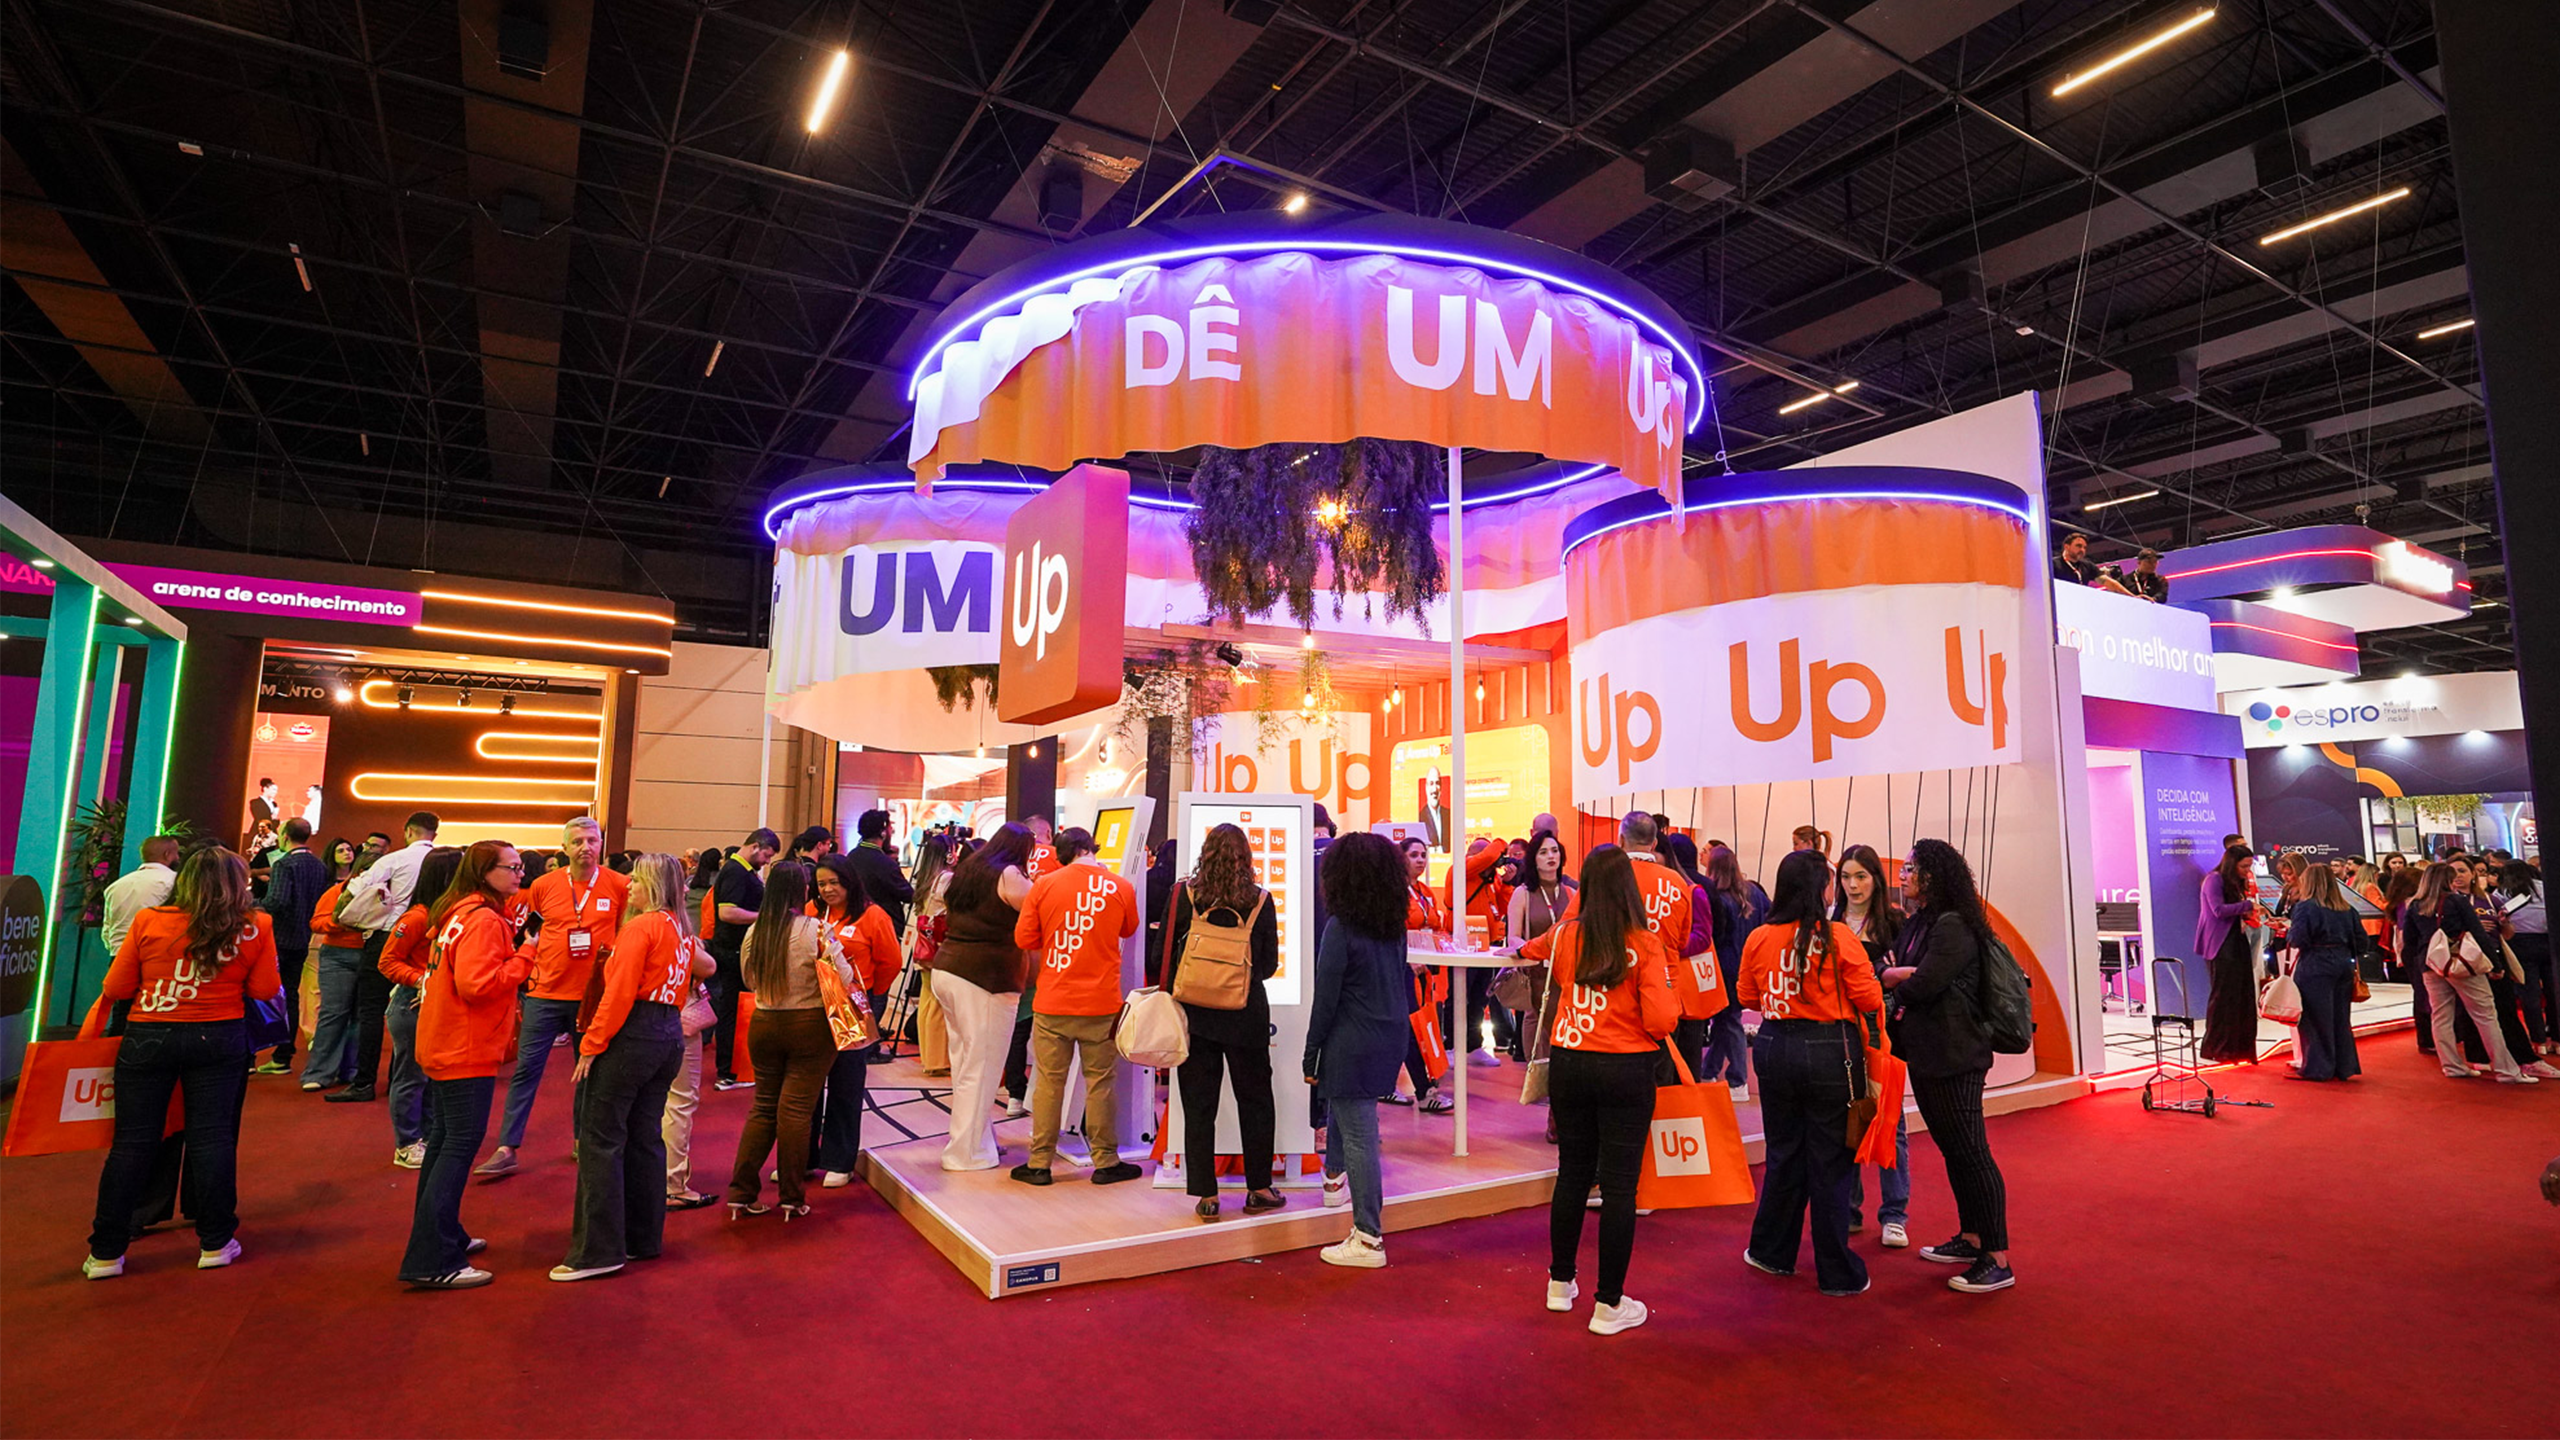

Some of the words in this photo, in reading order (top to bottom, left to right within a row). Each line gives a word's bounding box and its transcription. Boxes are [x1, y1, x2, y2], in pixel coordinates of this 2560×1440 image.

[1125, 284, 1241, 389] DÊ
[1386, 285, 1552, 409] UM
[153, 582, 220, 599] arena
[224, 587, 253, 601] de
[256, 592, 406, 616] conhecimento
[840, 551, 993, 635] UM
[1012, 539, 1069, 662] Up
[2103, 634, 2117, 660] o
[2122, 637, 2188, 673] melhor
[261, 683, 326, 699] MNTO
[1580, 672, 1662, 786] Up
[1728, 637, 1887, 764] Up
[2294, 704, 2380, 728] espro
[1289, 738, 1371, 814] Up
[2157, 788, 2190, 804] DECIDA
[2190, 790, 2210, 804] COM
[2158, 804, 2217, 823] INTELIGÊNCIA
[1250, 835, 1262, 846] Up
[1271, 835, 1284, 847] Up
[1271, 866, 1284, 877] Up
[1088, 875, 1117, 897] Up
[1658, 878, 1681, 904] Up
[1077, 892, 1106, 915] Up
[1645, 894, 1671, 920] Up
[2, 906, 40, 940] bene
[1065, 911, 1094, 935] Up
[1055, 930, 1083, 954] Up
[1046, 948, 1071, 972] Up
[1696, 961, 1713, 982] Up
[667, 963, 686, 990] Up
[1768, 970, 1800, 1000] Up
[1573, 982, 1608, 1014] Up
[1555, 1017, 1583, 1048] Up
[74, 1078, 114, 1108] Up
[1661, 1130, 1699, 1163] Up
